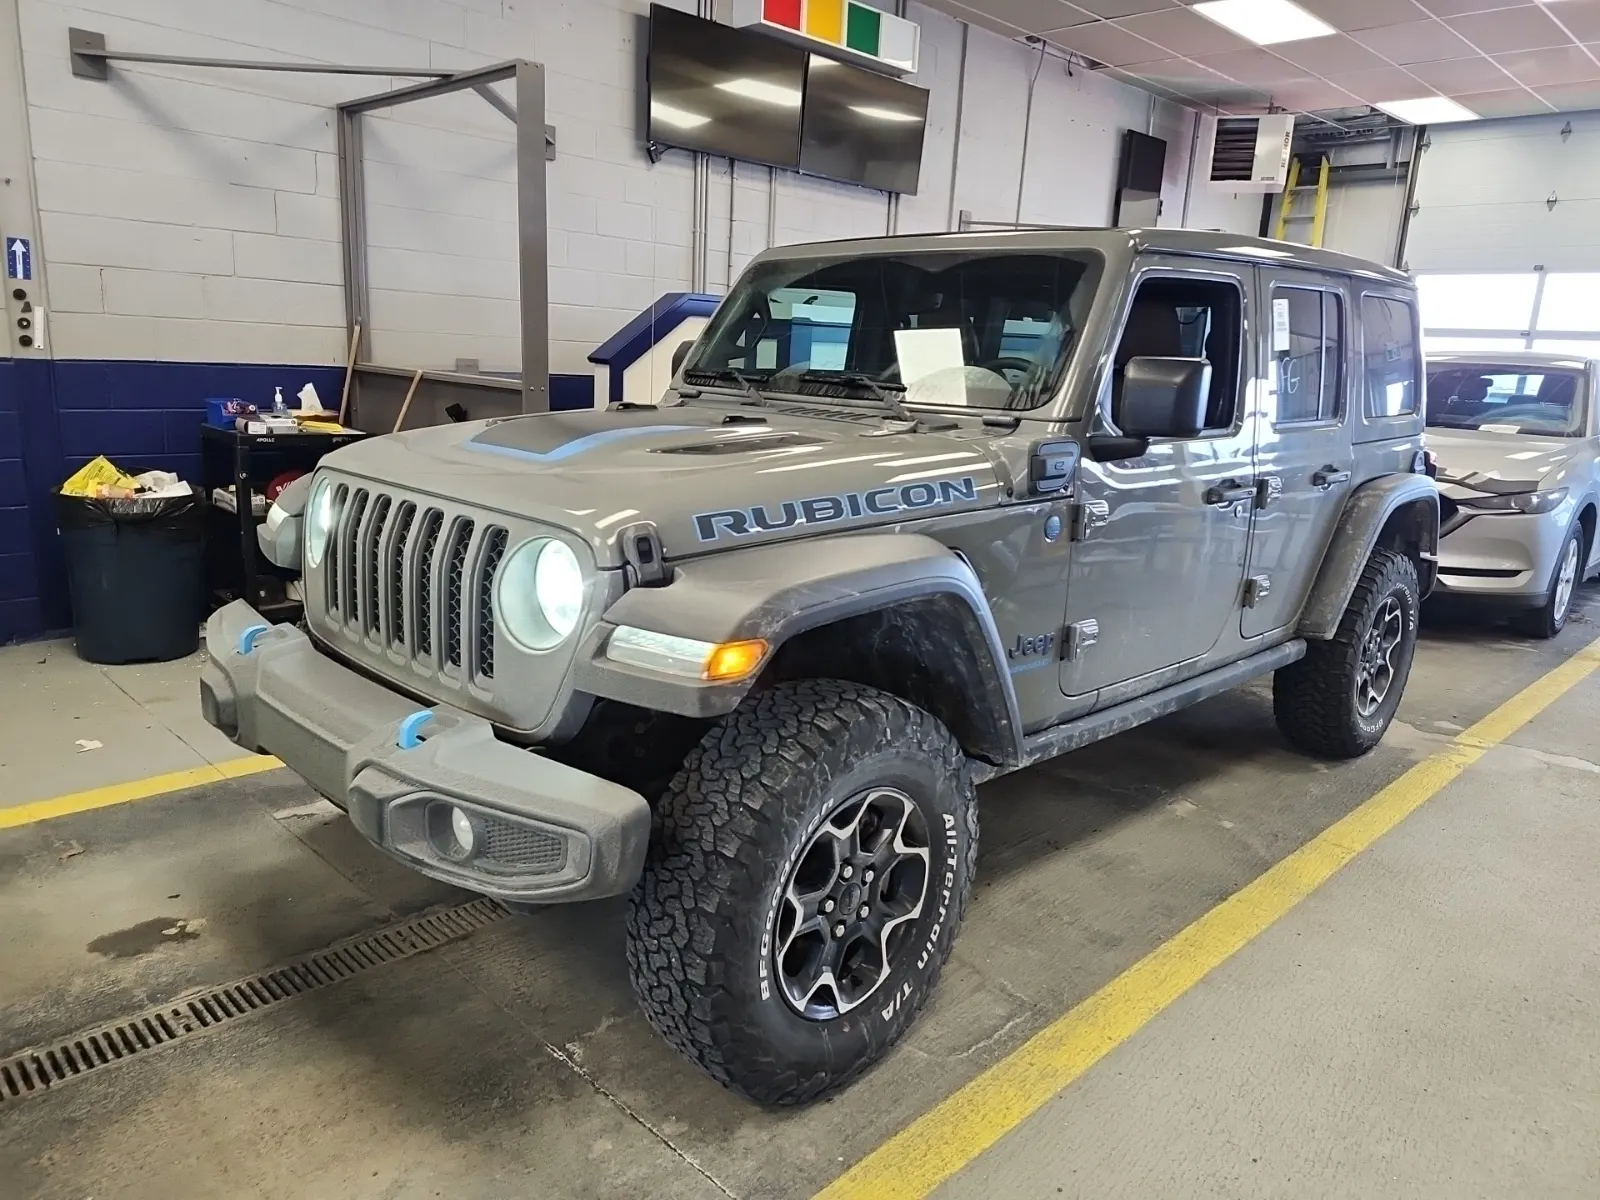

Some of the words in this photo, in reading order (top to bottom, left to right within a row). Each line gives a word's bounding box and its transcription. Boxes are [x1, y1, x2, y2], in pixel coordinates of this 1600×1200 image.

[692, 477, 978, 541] RUBICON
[1009, 632, 1056, 659] Jeep
[759, 798, 835, 1001] BFGoodrich
[917, 813, 958, 970] All-Terrain
[881, 982, 913, 1022] T/A
